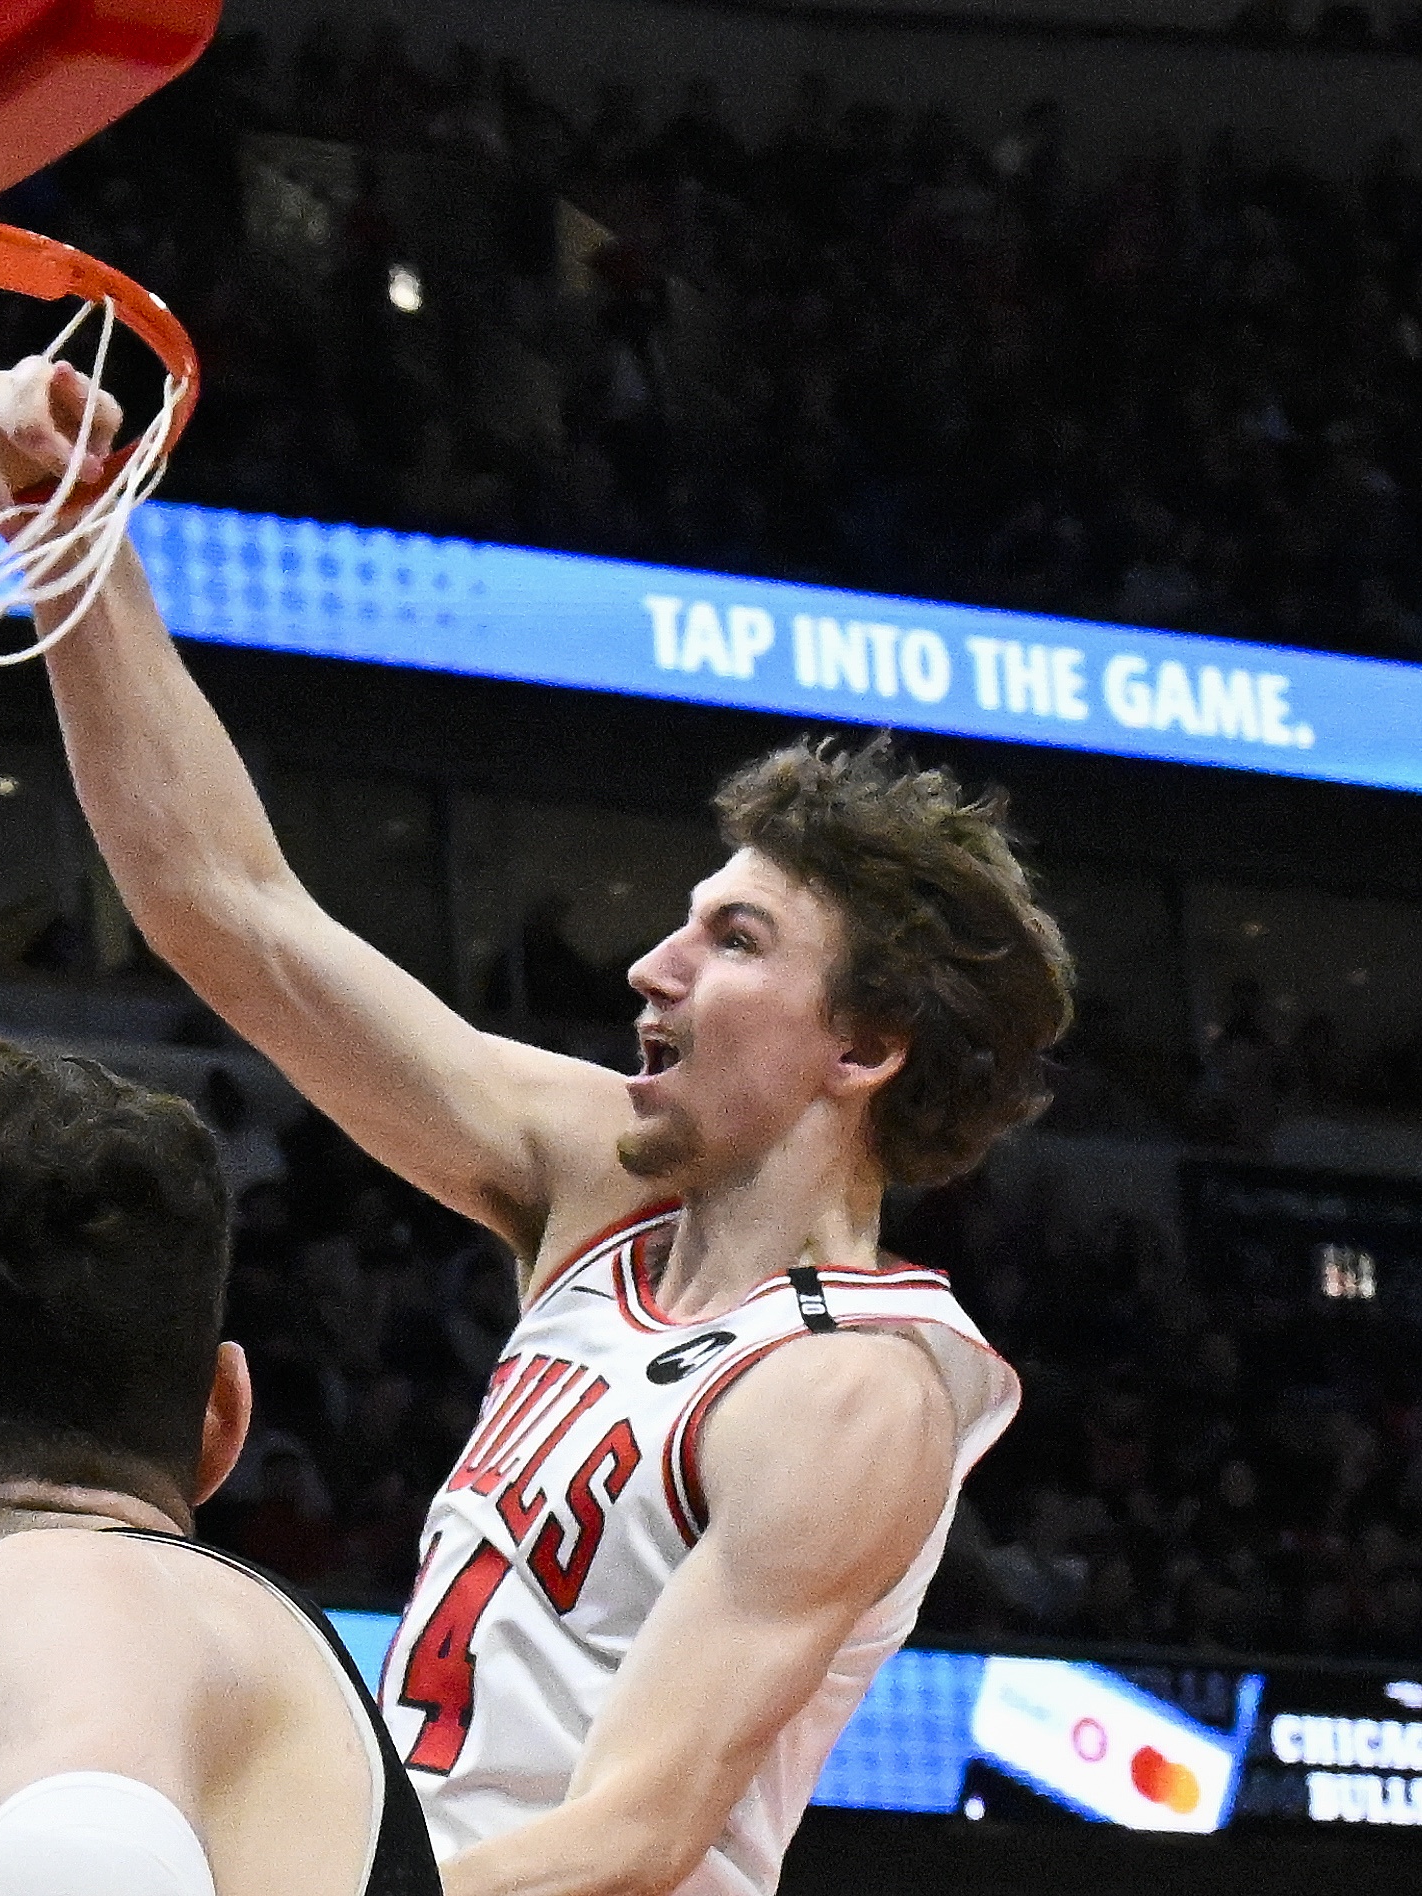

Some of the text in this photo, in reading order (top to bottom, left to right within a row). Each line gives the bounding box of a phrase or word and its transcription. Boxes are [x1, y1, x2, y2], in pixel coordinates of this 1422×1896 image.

[645, 594, 1315, 749] TAP INTO THE GAME.
[447, 1352, 642, 1616] ULLS
[377, 1530, 513, 1778] 4
